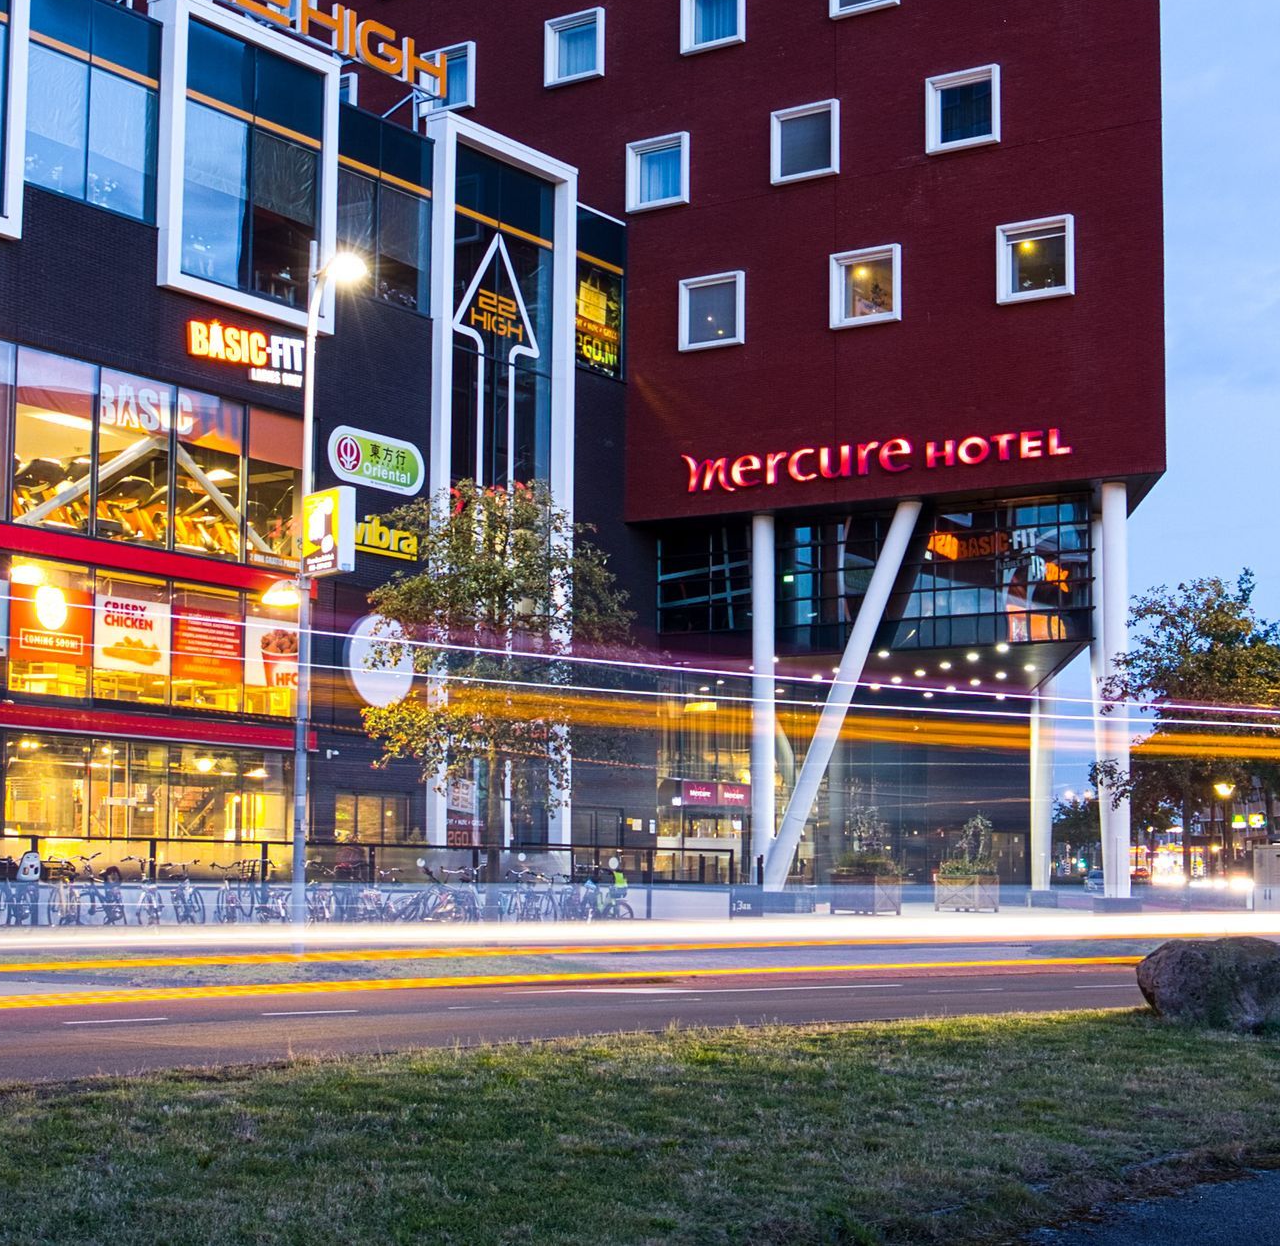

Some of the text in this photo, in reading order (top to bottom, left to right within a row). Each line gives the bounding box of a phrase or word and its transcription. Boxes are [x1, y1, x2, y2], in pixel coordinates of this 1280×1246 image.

[478, 288, 517, 321] 22
[471, 307, 523, 342] HIGH
[370, 443, 406, 466] 東方行
[926, 427, 1072, 468] HOTEL
[363, 462, 411, 485] Oriental
[104, 601, 147, 618] CRISPY
[104, 614, 153, 631] CHICKEN
[24, 634, 78, 649] COMING SOON!
[275, 672, 299, 687] HFC
